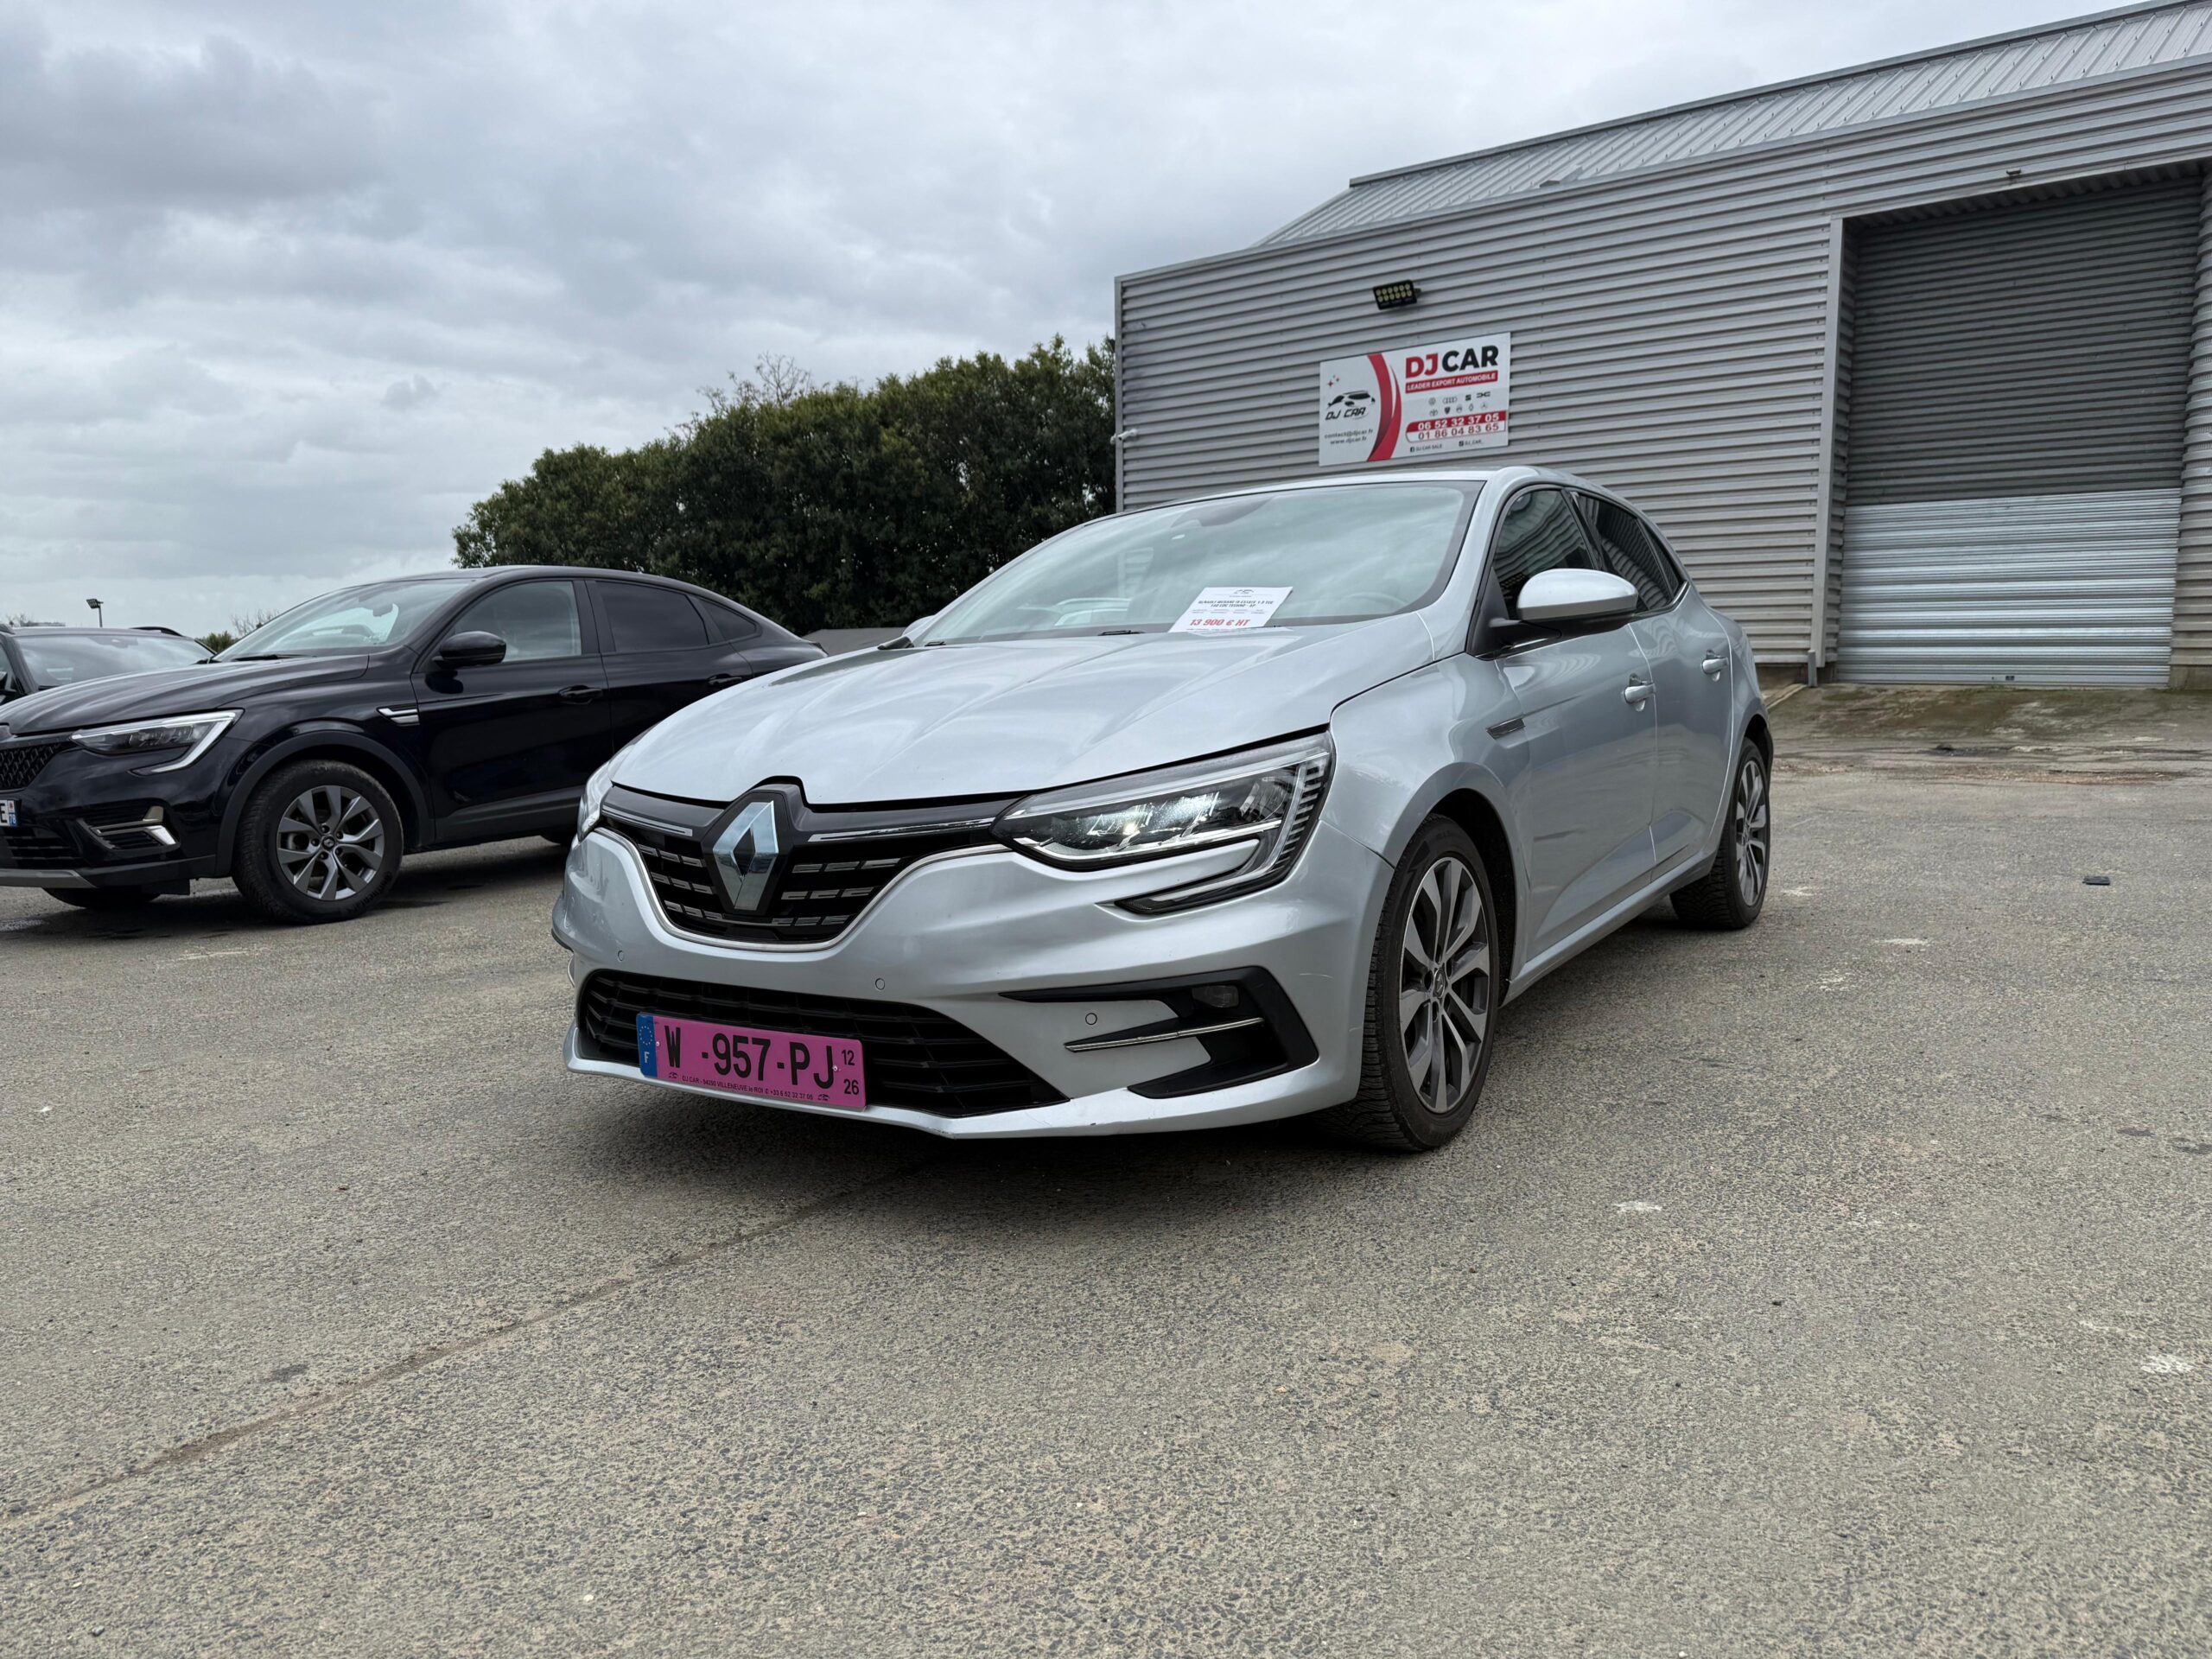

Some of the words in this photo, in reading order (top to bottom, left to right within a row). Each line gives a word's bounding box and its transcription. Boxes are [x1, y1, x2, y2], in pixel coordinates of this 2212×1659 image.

[1442, 345, 1499, 372] CAR
[1407, 380, 1431, 391] LEADER
[1432, 378, 1456, 388] EXPORT
[1456, 372, 1497, 385] AUTOMOBILE
[1325, 410, 1341, 420] DJ
[1344, 407, 1366, 417] CAR
[1418, 422, 1431, 430] 06
[1434, 419, 1447, 429] 52
[1452, 417, 1465, 426] 32
[1468, 415, 1481, 424] 37
[1485, 413, 1499, 422] 05
[1434, 429, 1447, 438] 86
[1452, 427, 1464, 436] 04
[1468, 425, 1481, 434] 83
[1485, 422, 1498, 431] 65
[644, 1052, 650, 1064] F
[842, 1049, 855, 1066] 12
[717, 1081, 749, 1091] VILLENEUVE
[842, 1078, 859, 1096] 26
